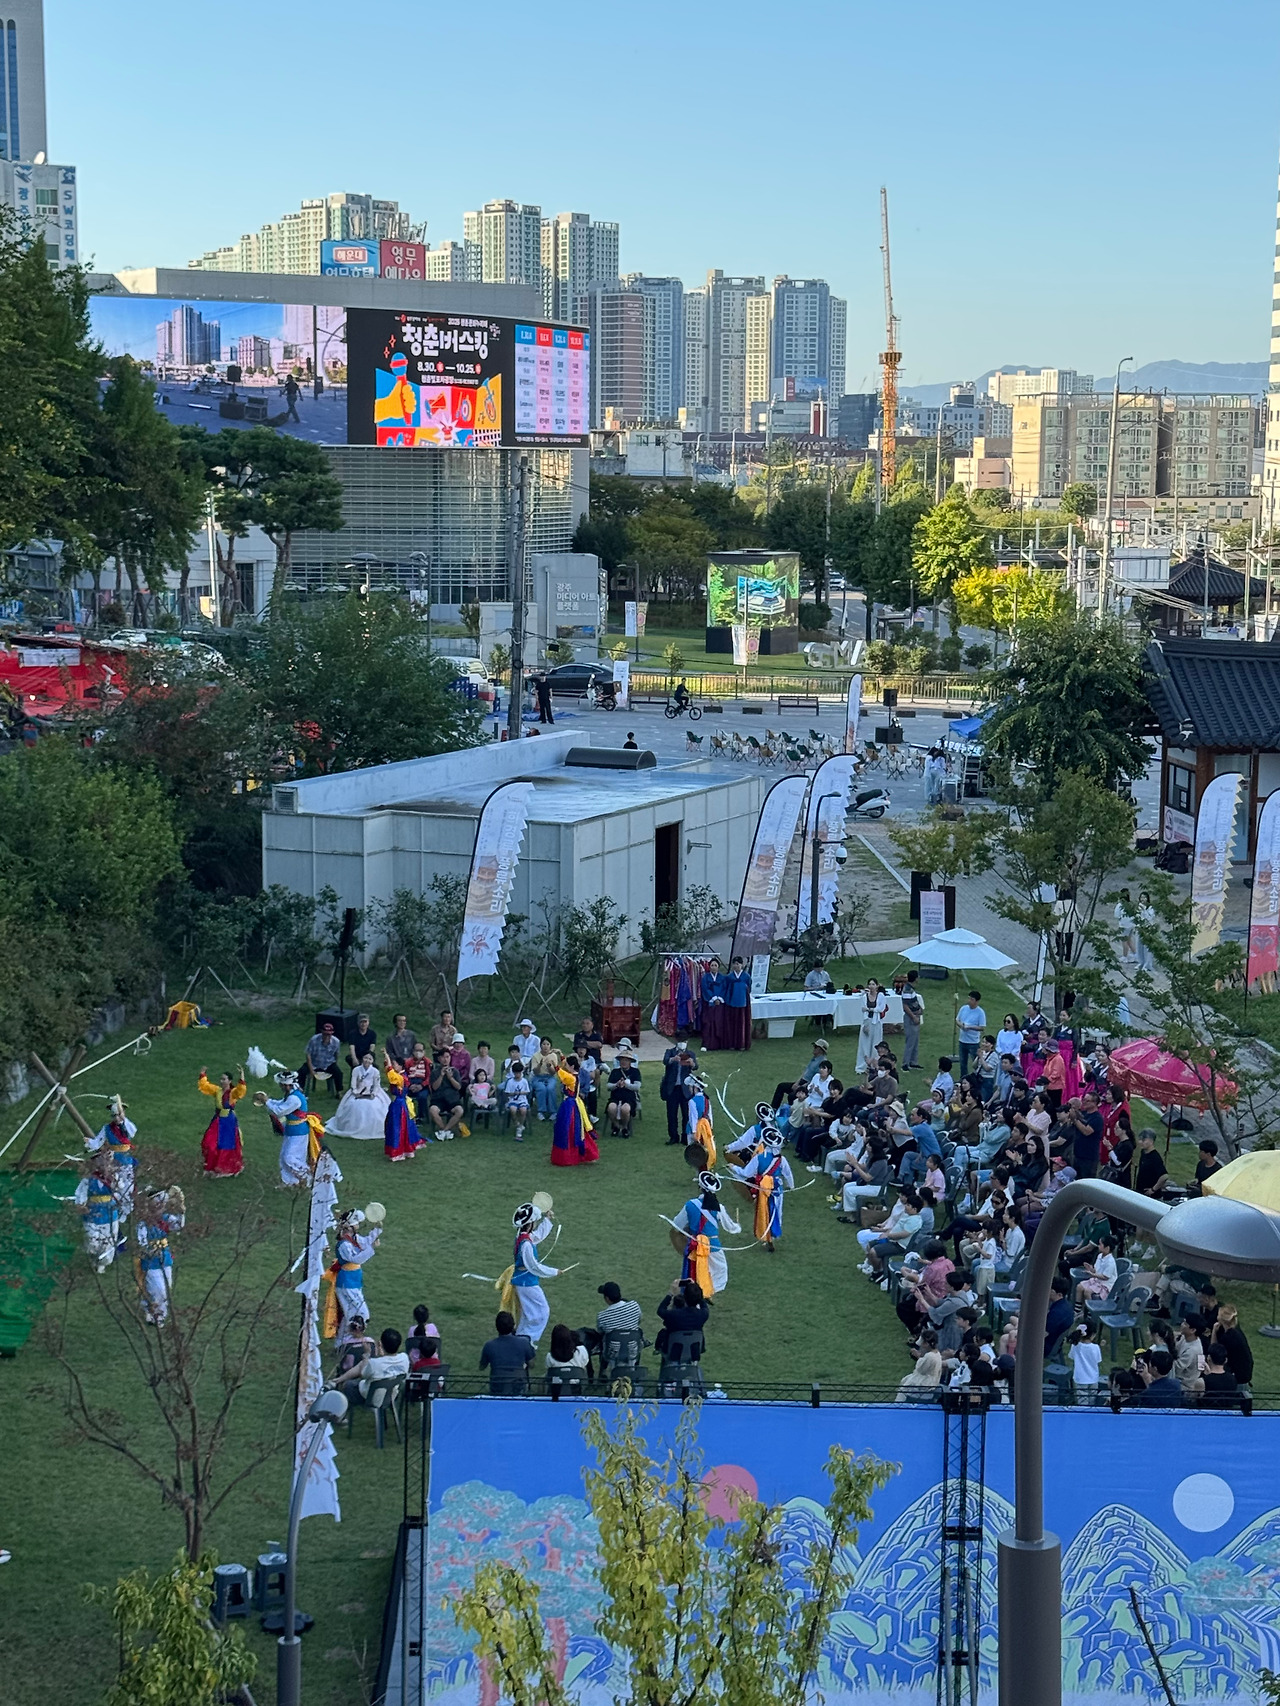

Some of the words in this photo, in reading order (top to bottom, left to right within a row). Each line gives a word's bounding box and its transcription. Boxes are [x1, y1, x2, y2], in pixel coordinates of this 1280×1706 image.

[337, 250, 364, 261] 해운대
[391, 246, 417, 266] 영무
[401, 323, 488, 360] 청춘버스킹
[556, 582, 571, 592] 광주
[556, 593, 579, 601] 미디어
[581, 593, 597, 601] 아트
[556, 602, 579, 611] 플랫폼
[803, 639, 870, 669] GMA
